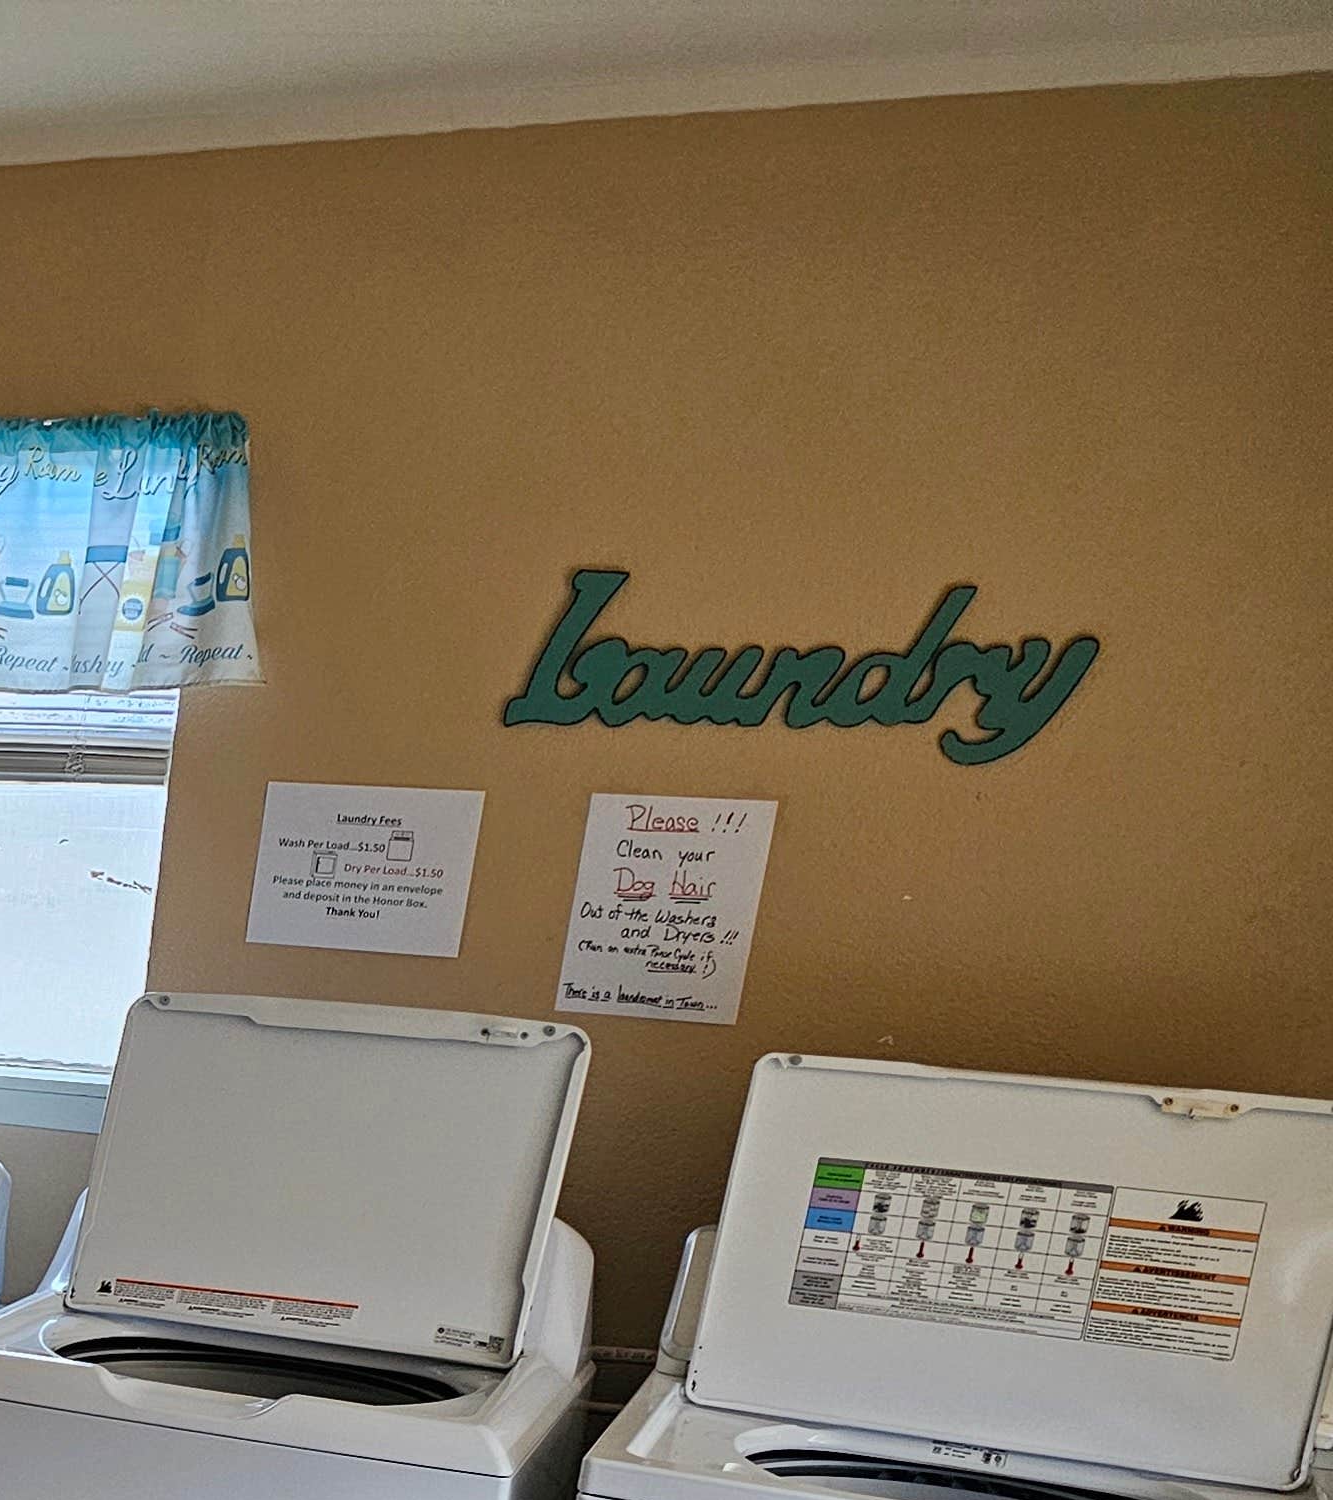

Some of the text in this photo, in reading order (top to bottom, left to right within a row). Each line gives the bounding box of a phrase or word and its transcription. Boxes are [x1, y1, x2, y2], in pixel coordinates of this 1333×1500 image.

[180, 644, 244, 668] Repeat
[503, 568, 1100, 766] Laundry
[336, 813, 403, 827] Laundry Fees
[626, 804, 700, 833] Please
[278, 838, 305, 848] Wash
[307, 839, 324, 849] Per
[617, 840, 715, 867] Clean your
[343, 863, 362, 874] Dry
[364, 865, 381, 875] Per
[272, 875, 444, 896] Please place money in an envelope
[613, 867, 717, 897] Dog Hair
[283, 891, 300, 900] and
[303, 891, 340, 903] deposit
[342, 894, 351, 903] in
[353, 894, 370, 904] the
[372, 896, 404, 906] Honor
[326, 906, 381, 920] Thank You!
[580, 901, 717, 928] Out of the Washers
[620, 926, 651, 939] and
[663, 924, 716, 944] Dryers
